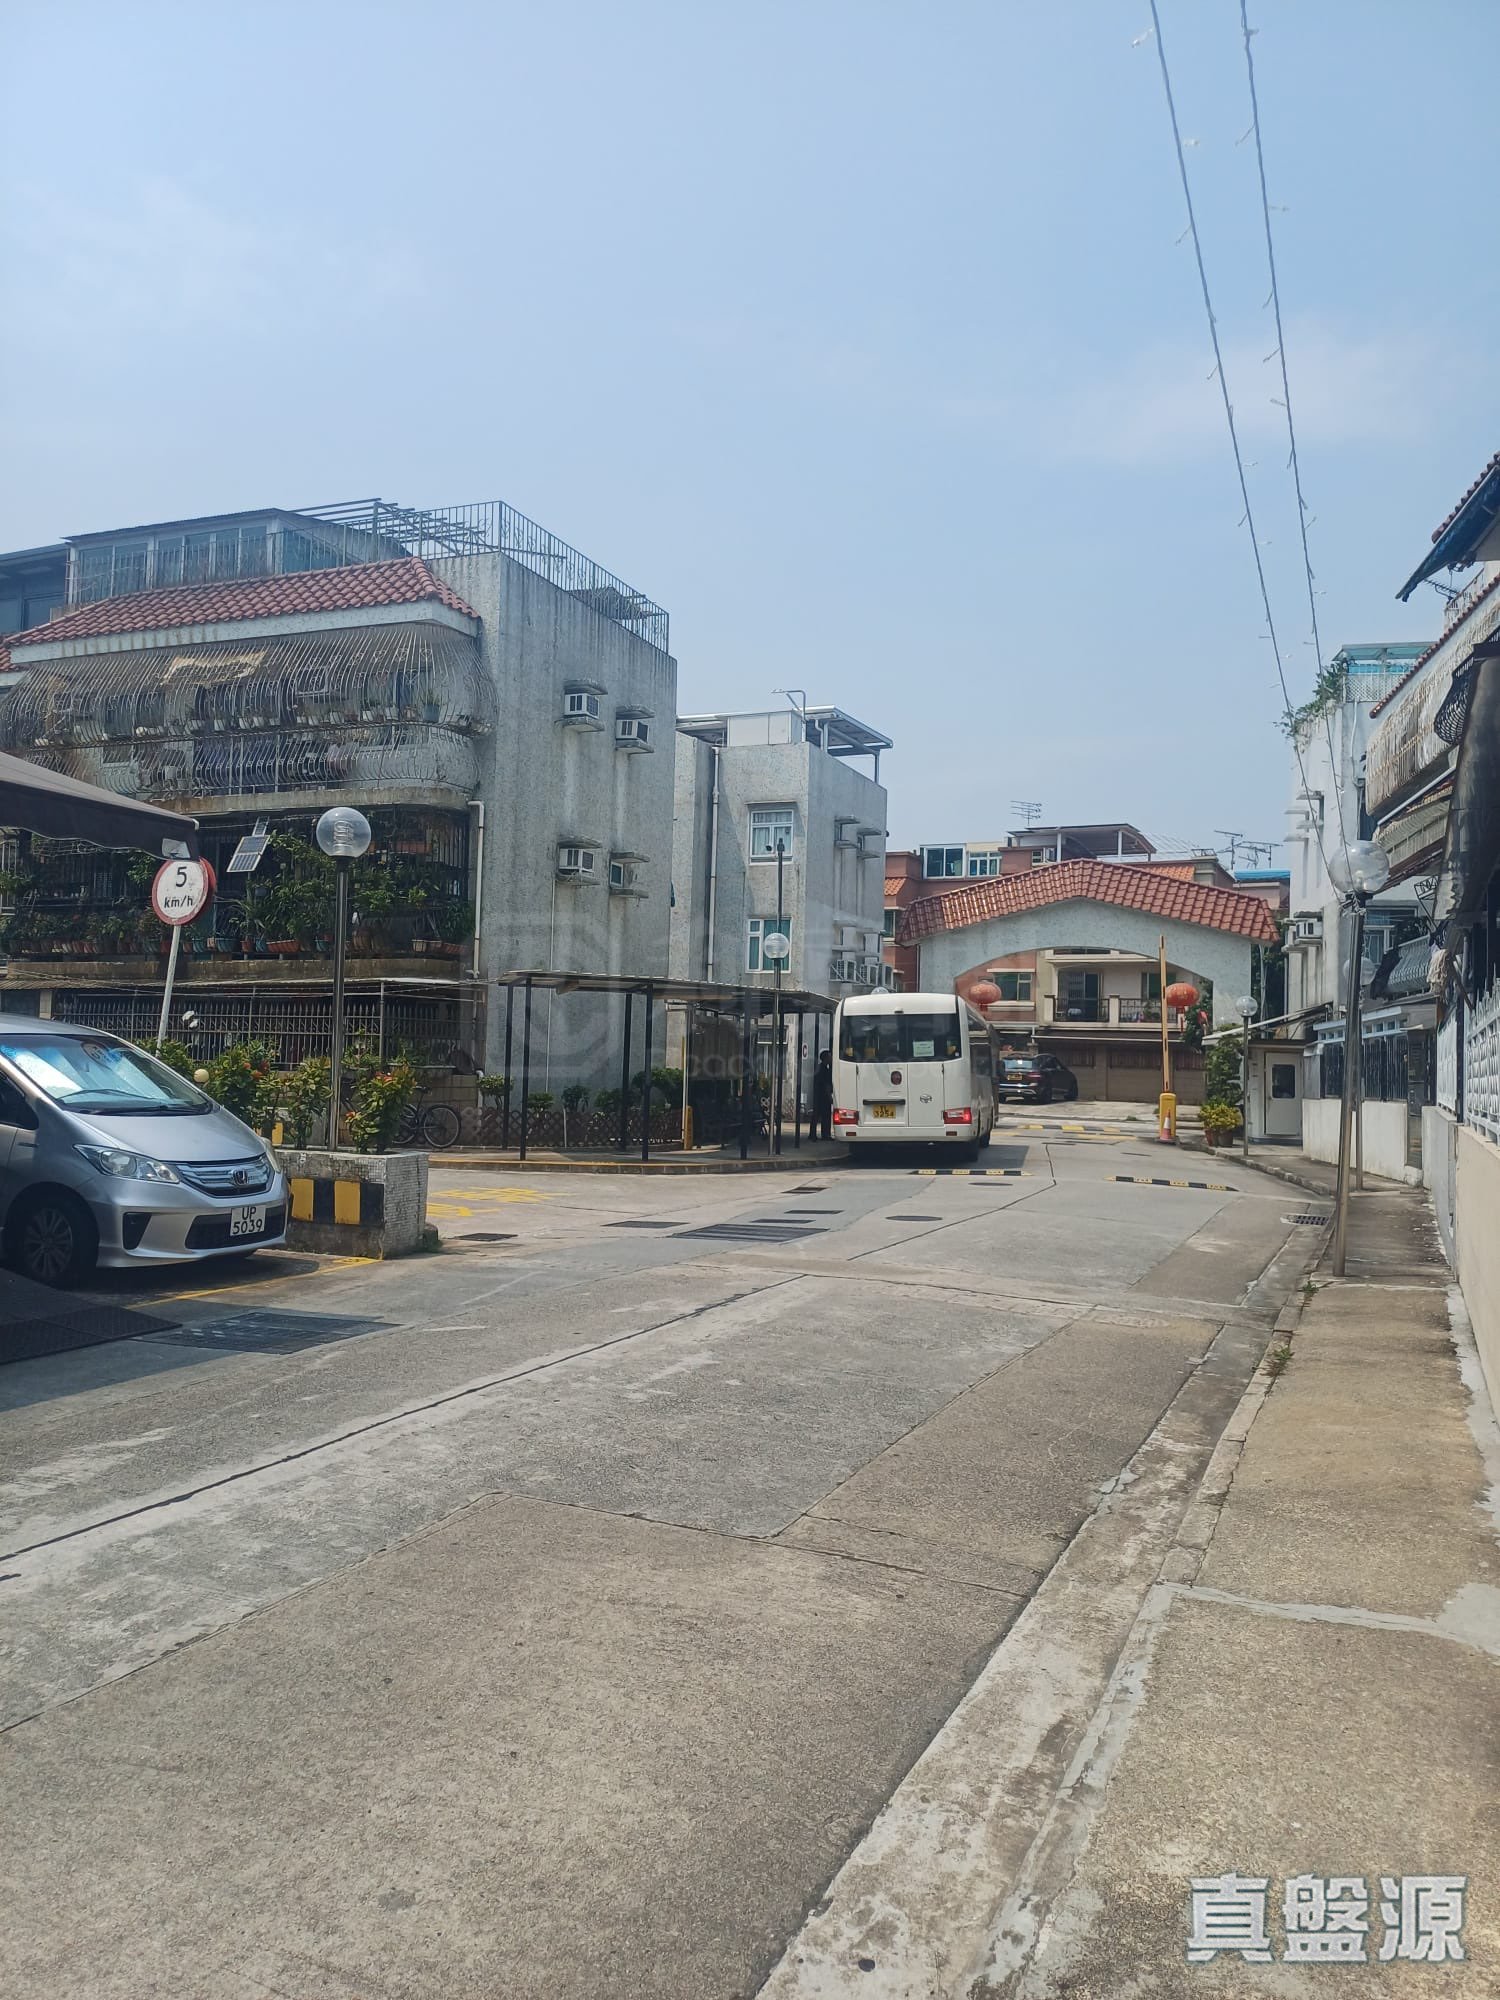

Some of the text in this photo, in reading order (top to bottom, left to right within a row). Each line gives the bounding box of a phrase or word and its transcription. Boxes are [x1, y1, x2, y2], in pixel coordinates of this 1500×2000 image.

[175, 866, 187, 888] 5
[164, 895, 193, 909] km/h
[241, 1206, 257, 1220] UP
[232, 1218, 263, 1235] 5039
